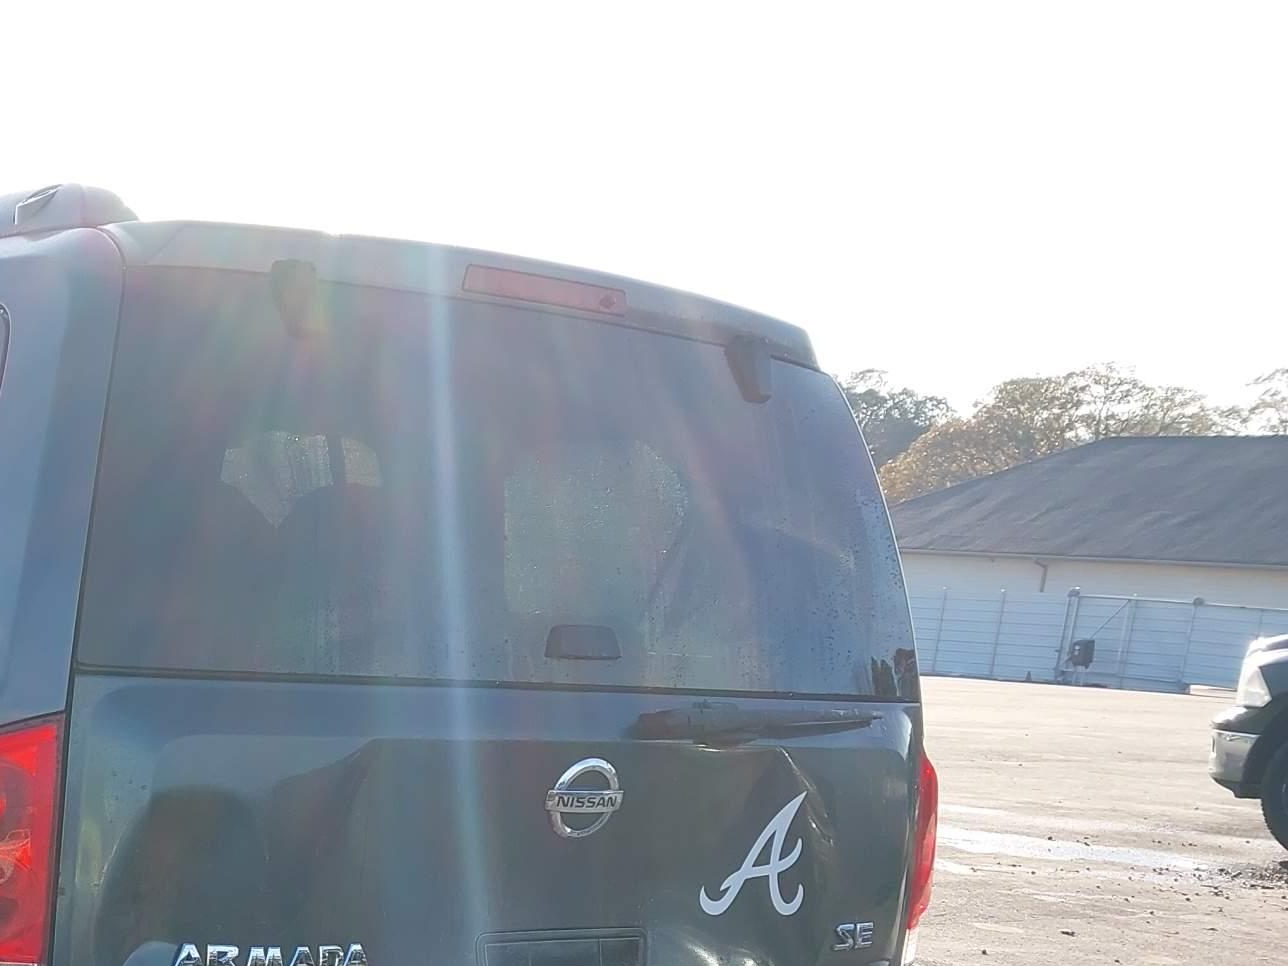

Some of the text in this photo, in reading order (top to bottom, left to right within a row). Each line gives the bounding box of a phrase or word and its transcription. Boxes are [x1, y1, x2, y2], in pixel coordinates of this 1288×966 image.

[556, 796, 617, 808] NISSAN
[699, 790, 804, 916] A
[833, 921, 874, 951] SE
